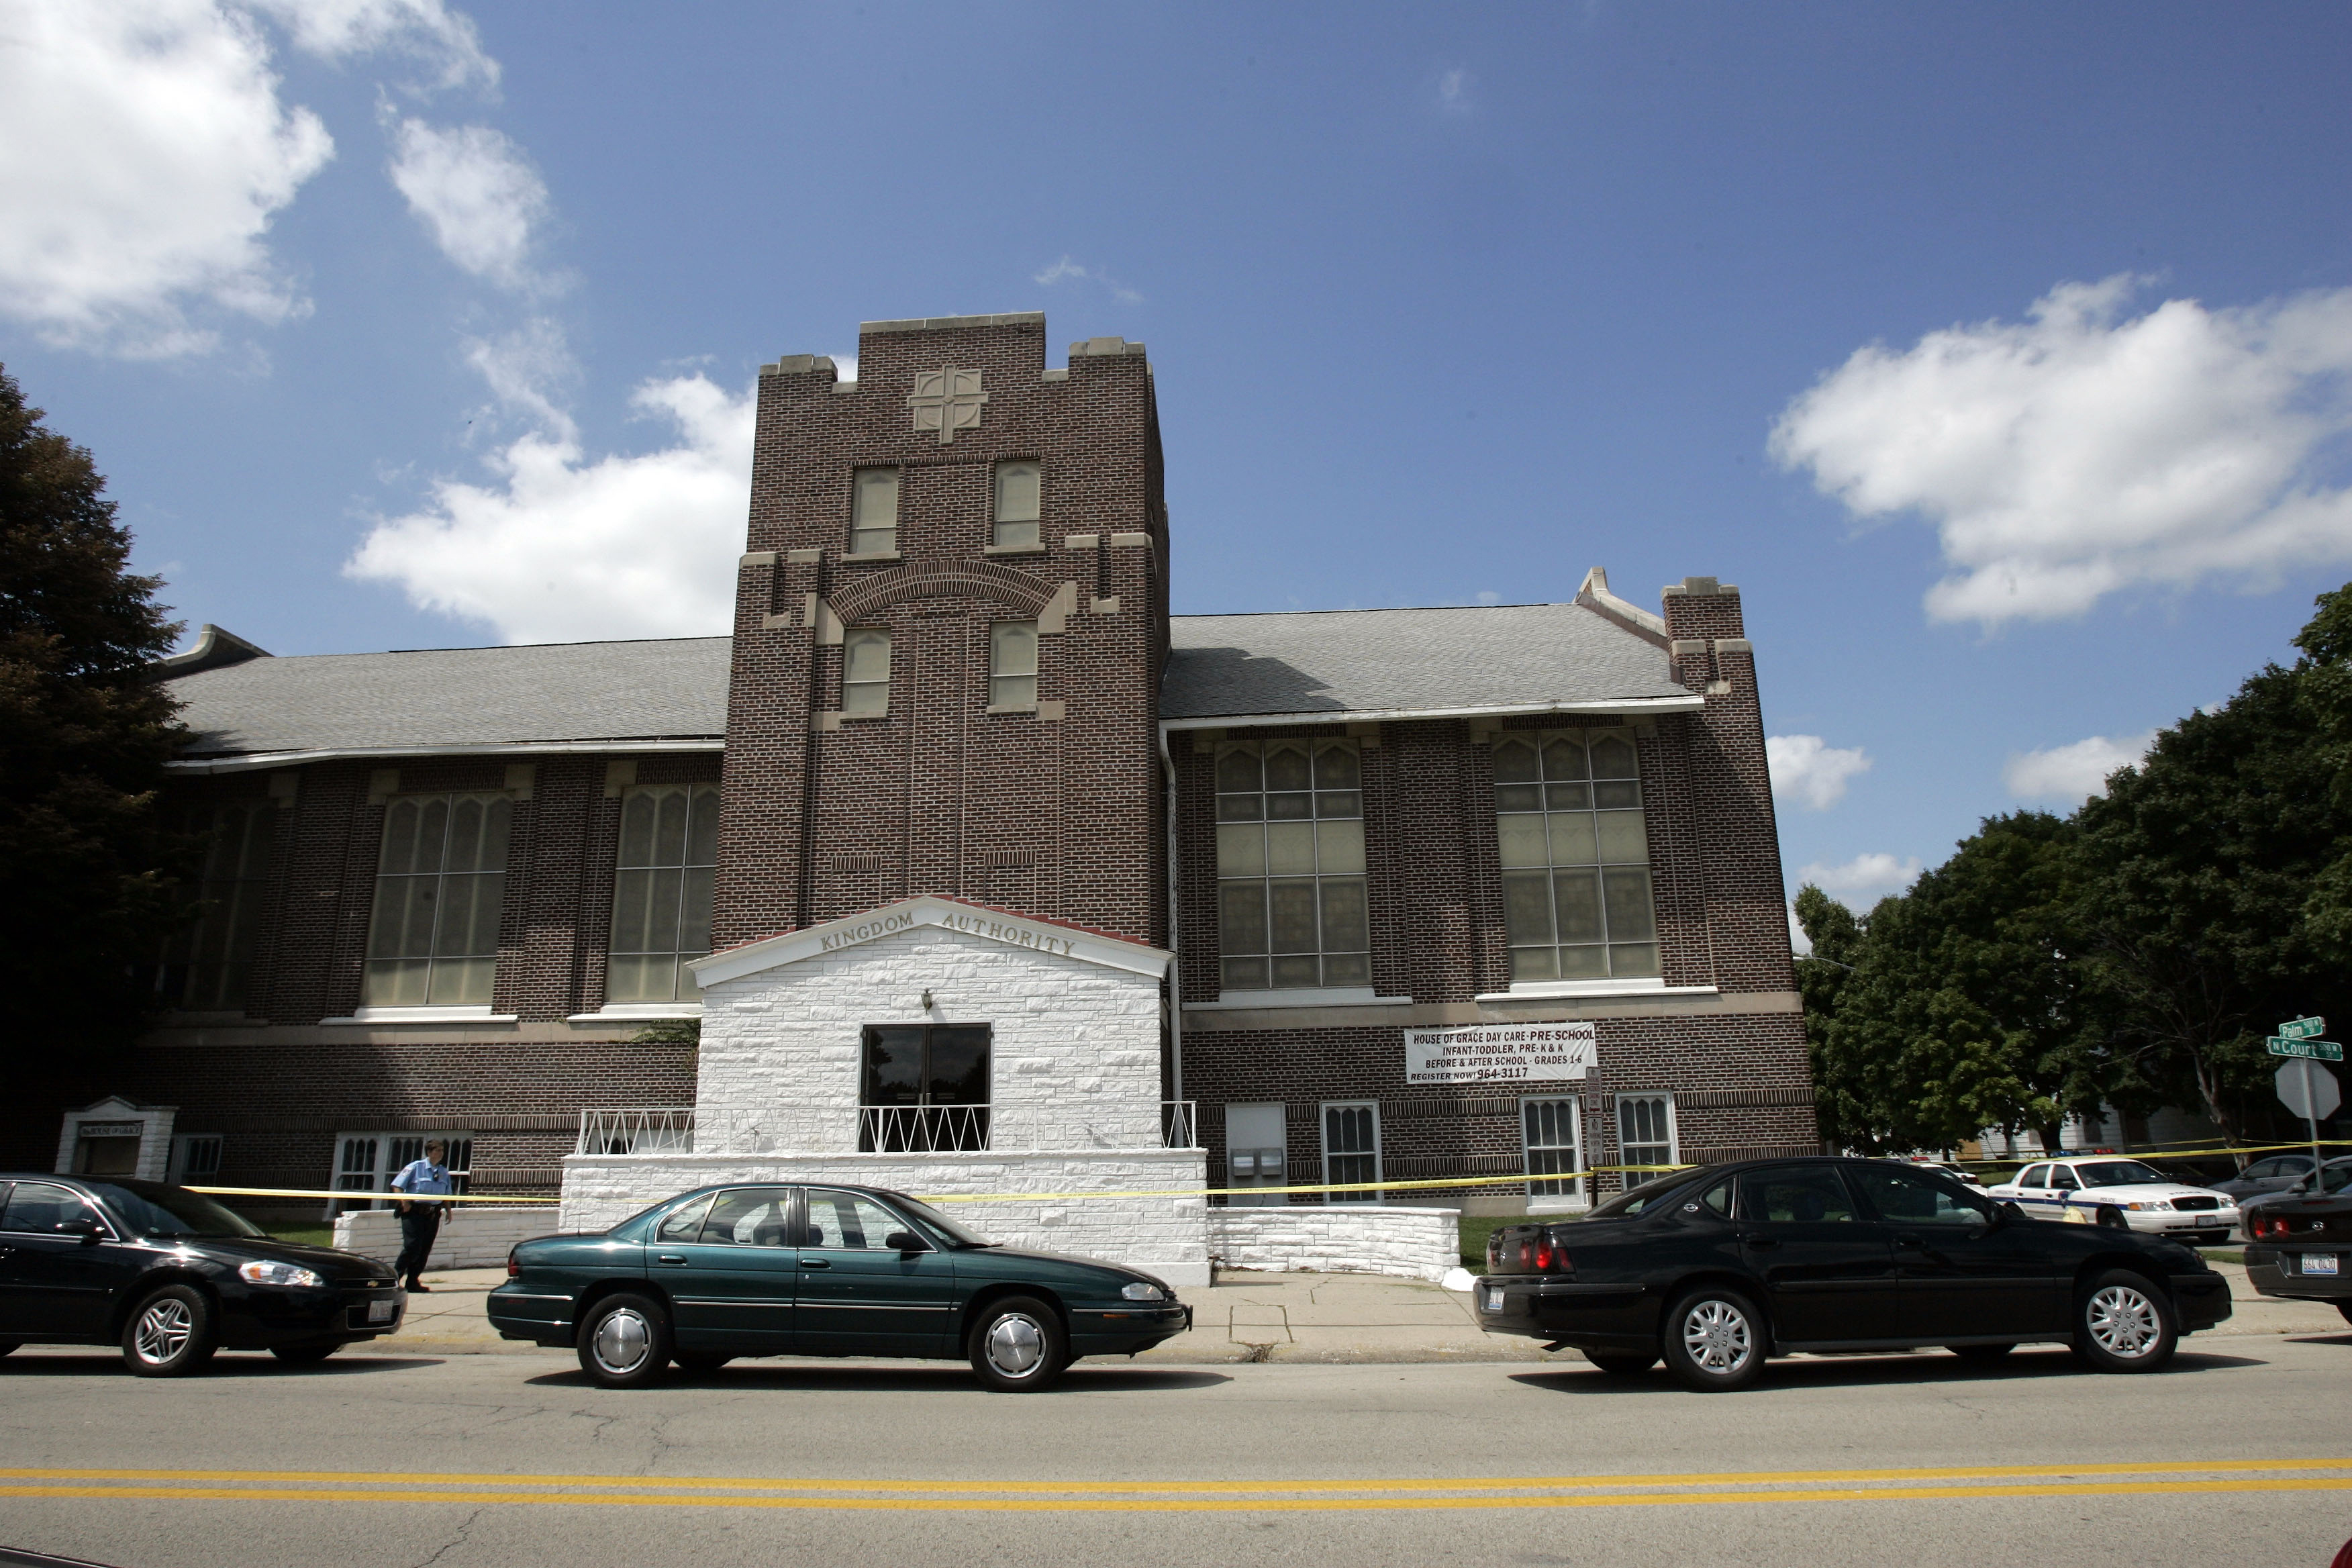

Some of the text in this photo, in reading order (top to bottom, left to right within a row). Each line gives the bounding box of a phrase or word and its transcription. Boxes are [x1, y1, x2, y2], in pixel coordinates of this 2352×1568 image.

[820, 912, 1075, 954] KINGDOM AUTHORITY
[1414, 1034, 1440, 1044] HOUSE
[1444, 1034, 1454, 1044] OF
[1457, 1032, 1483, 1043] GRACE
[1486, 1032, 1502, 1042] DAY
[2282, 1025, 2304, 1037] Palm
[1549, 1043, 1555, 1052] &
[1558, 1043, 1563, 1052] K
[2273, 1042, 2280, 1050] N
[2282, 1040, 2317, 1056] Court
[1426, 1059, 1457, 1069] BEFORE
[1459, 1058, 1465, 1067] &
[1468, 1057, 1492, 1067] AFTER
[1495, 1056, 1527, 1066] SCHOOL
[1534, 1055, 1567, 1065] GRADES
[1570, 1055, 1582, 1064] 1-6
[1410, 1073, 1451, 1081] REGISTER
[1477, 1067, 1528, 1079] 964-3117
